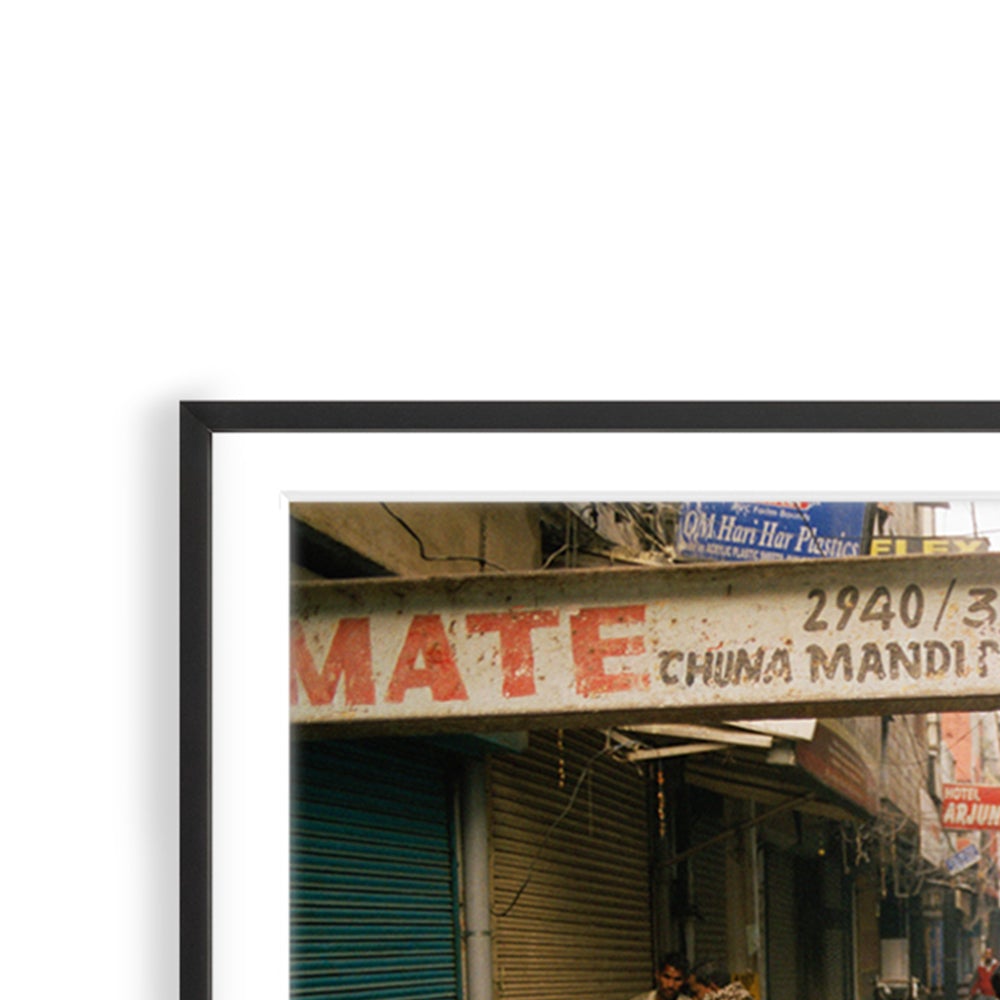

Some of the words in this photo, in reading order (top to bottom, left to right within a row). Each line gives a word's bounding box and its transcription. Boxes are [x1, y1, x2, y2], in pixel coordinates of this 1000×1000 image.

[717, 514, 759, 545] Hari
[758, 520, 794, 550] Har
[803, 578, 998, 632] 2940/3
[290, 604, 652, 707] MATE
[805, 640, 966, 684] MANDI
[944, 787, 982, 802] HOTEL
